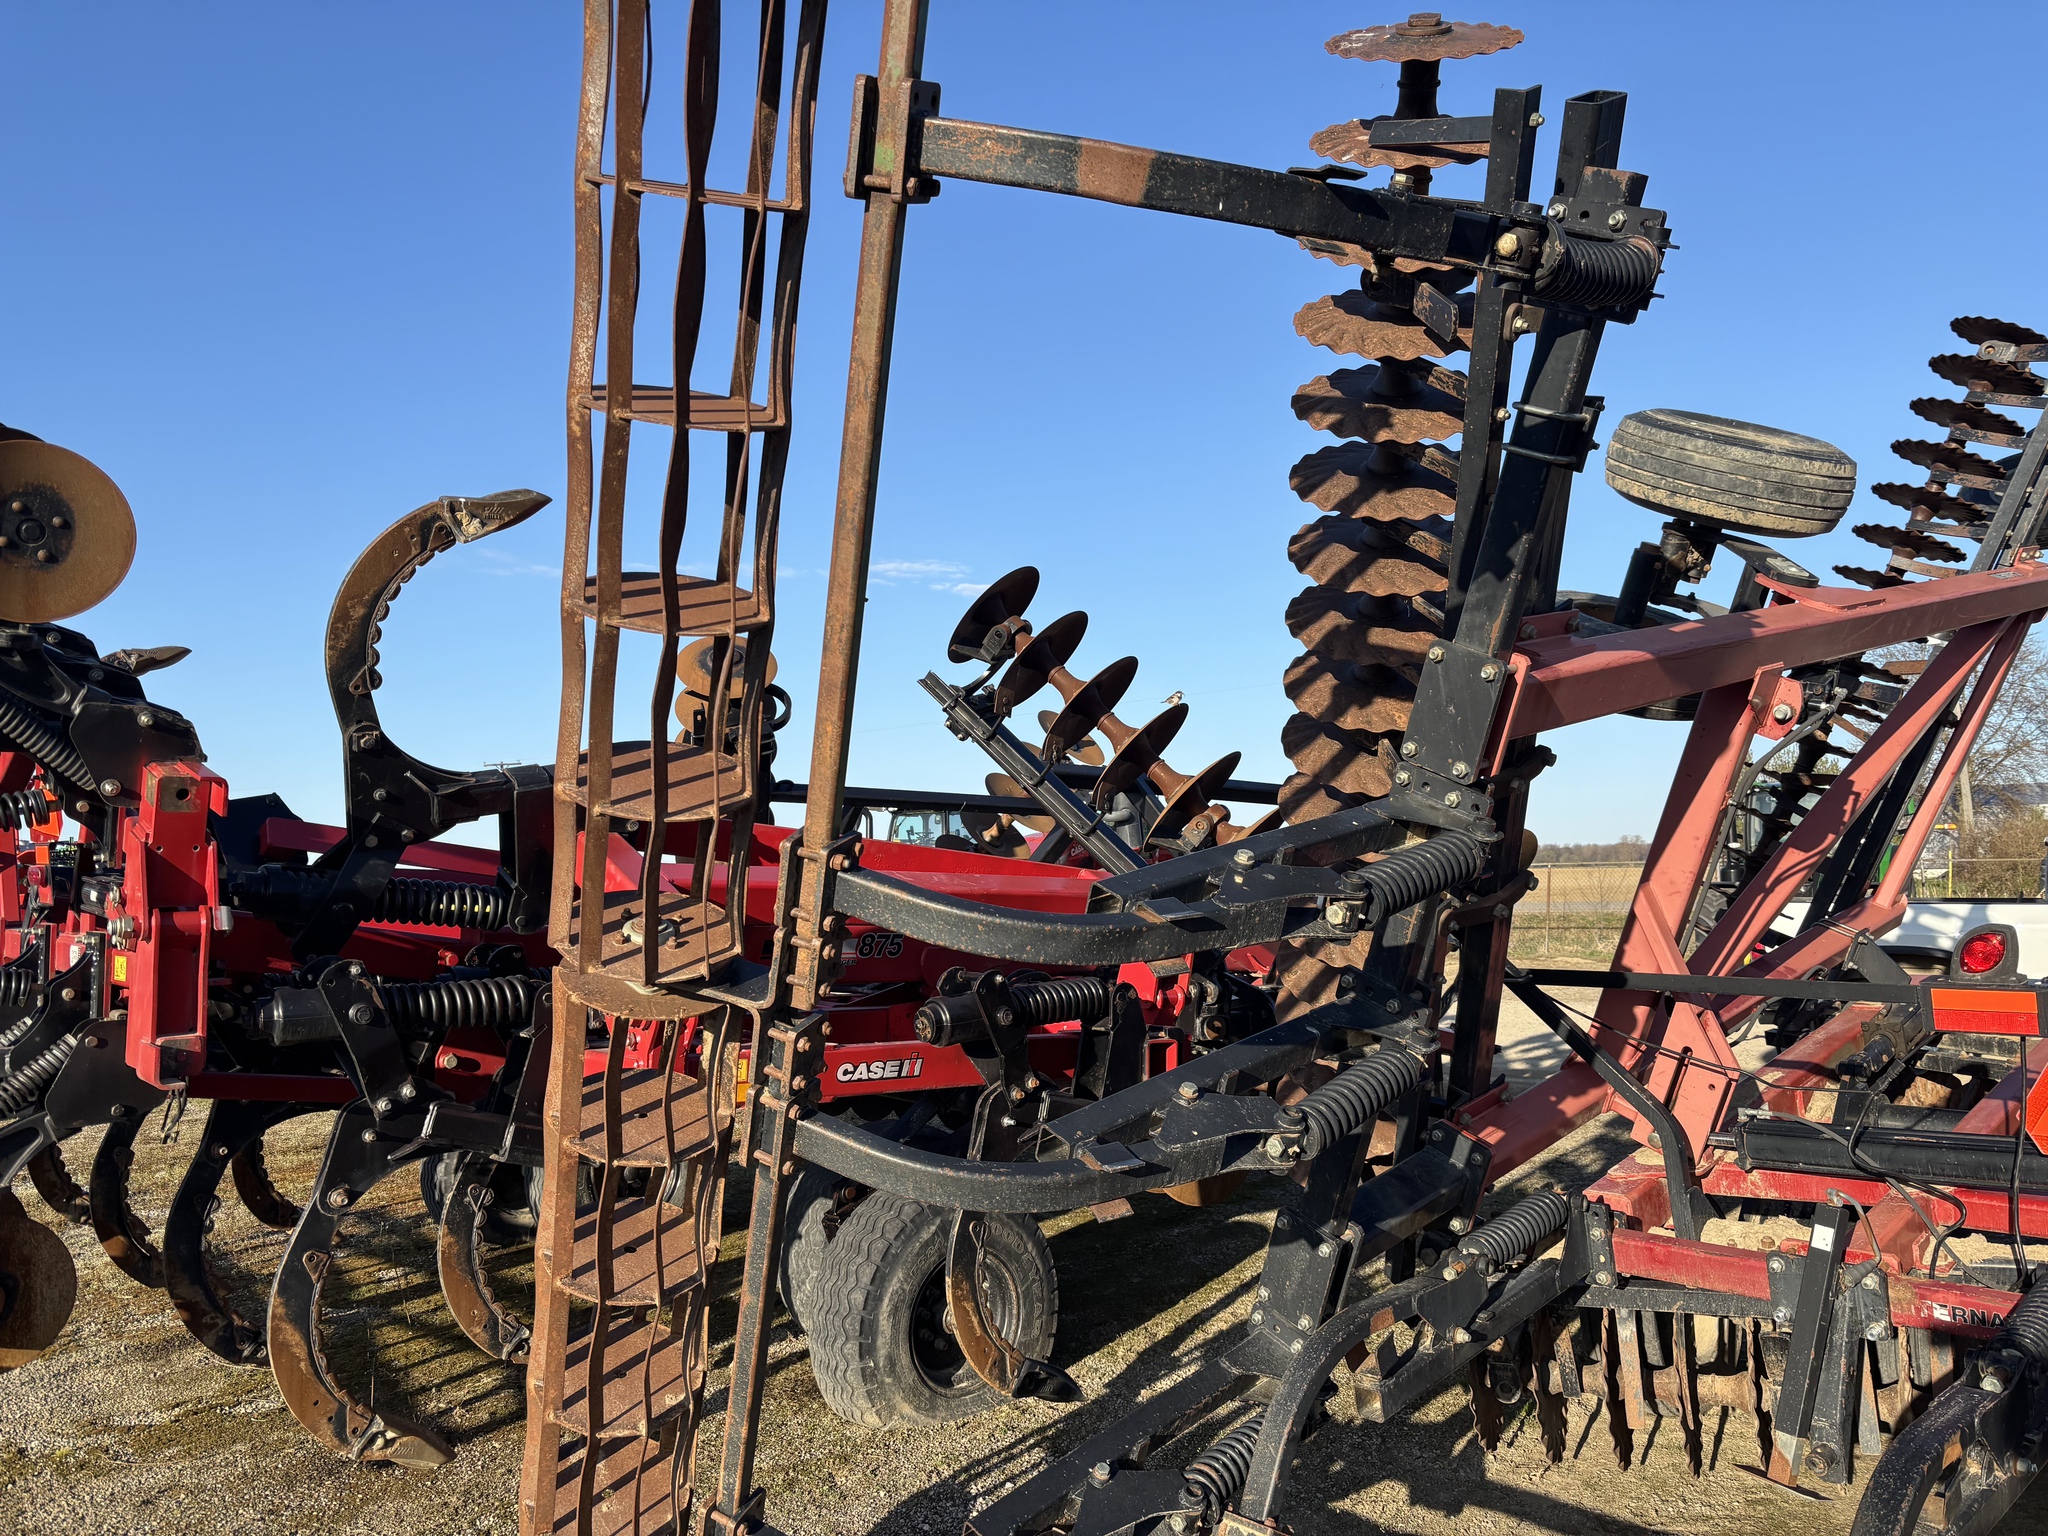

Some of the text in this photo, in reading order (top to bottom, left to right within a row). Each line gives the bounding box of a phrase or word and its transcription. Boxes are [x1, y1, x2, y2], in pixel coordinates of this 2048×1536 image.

[857, 932, 905, 958] 875
[836, 1059, 902, 1082] CASE
[985, 1220, 1043, 1338] OODYEAR
